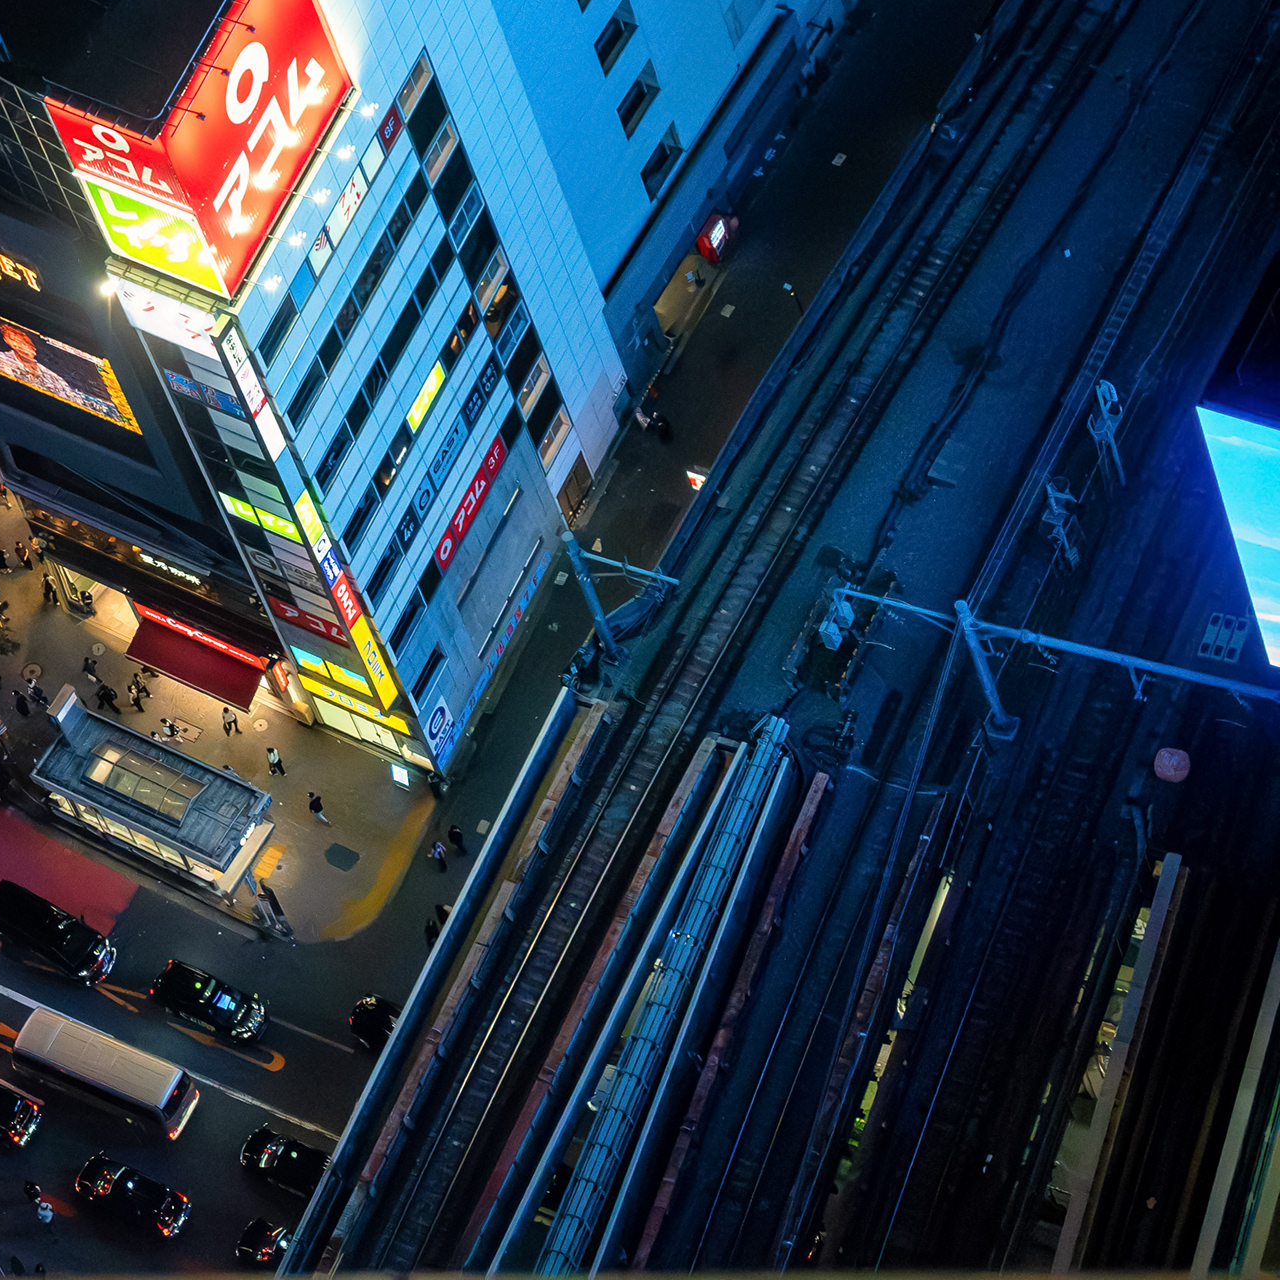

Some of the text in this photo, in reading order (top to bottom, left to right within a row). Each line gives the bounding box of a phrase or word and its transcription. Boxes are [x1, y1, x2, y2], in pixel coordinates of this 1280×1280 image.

[73, 138, 175, 194] アコム
[213, 57, 325, 238] アコム
[487, 442, 502, 470] 3F
[232, 498, 297, 541] レイク
[454, 478, 487, 532] アコム
[279, 600, 348, 641] アコム
[321, 684, 387, 721] プロミス
